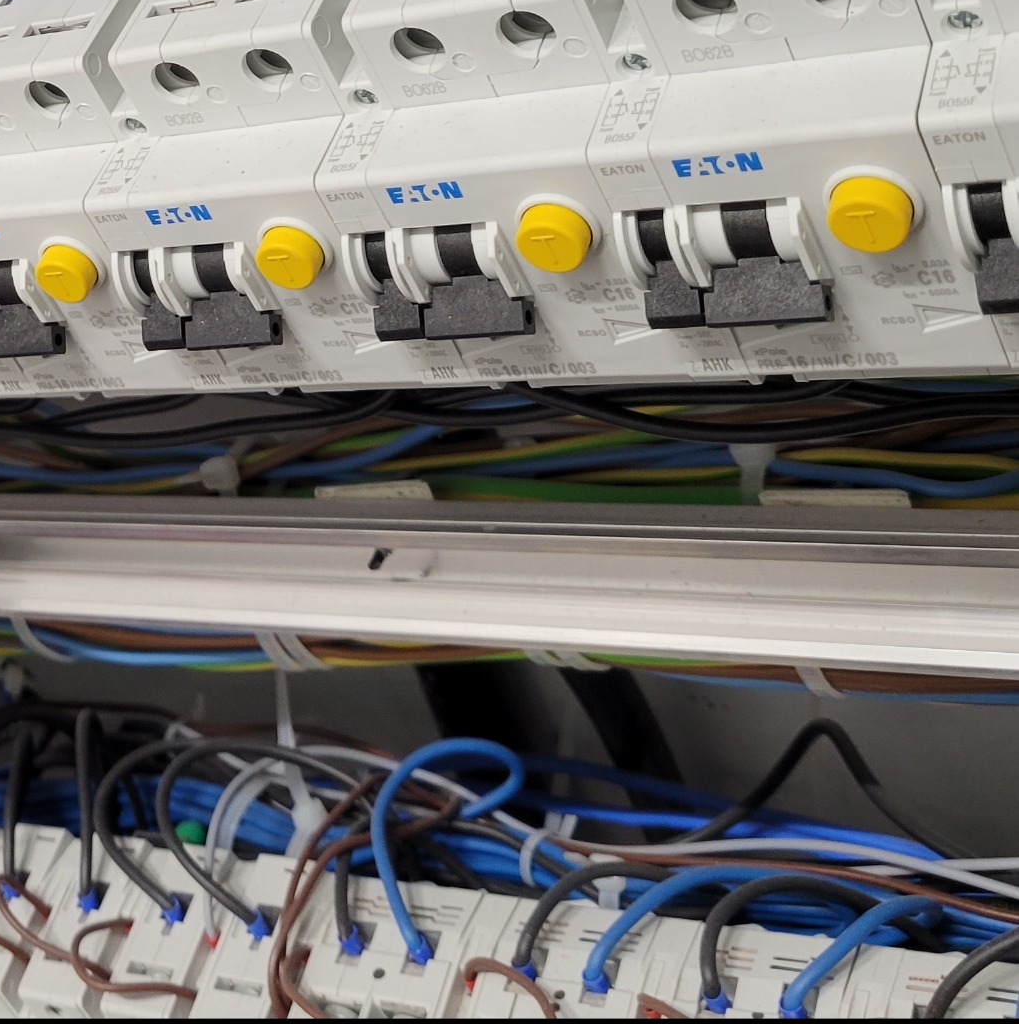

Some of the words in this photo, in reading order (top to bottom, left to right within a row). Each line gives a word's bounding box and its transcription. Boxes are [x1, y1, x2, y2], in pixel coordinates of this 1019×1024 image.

[681, 43, 735, 65] BO62B
[402, 81, 448, 99] BO62B
[932, 131, 988, 147] EATON
[599, 163, 646, 178] EATON
[672, 151, 764, 179] EATON
[326, 190, 366, 204] EATON
[386, 181, 464, 205] EATON
[93, 212, 129, 225] EATON
[145, 204, 214, 226] EATON
[916, 269, 958, 286] C16
[602, 286, 638, 302] C16
[340, 300, 370, 316] C16
[880, 314, 917, 326] RCBO
[577, 329, 608, 338] RCBO
